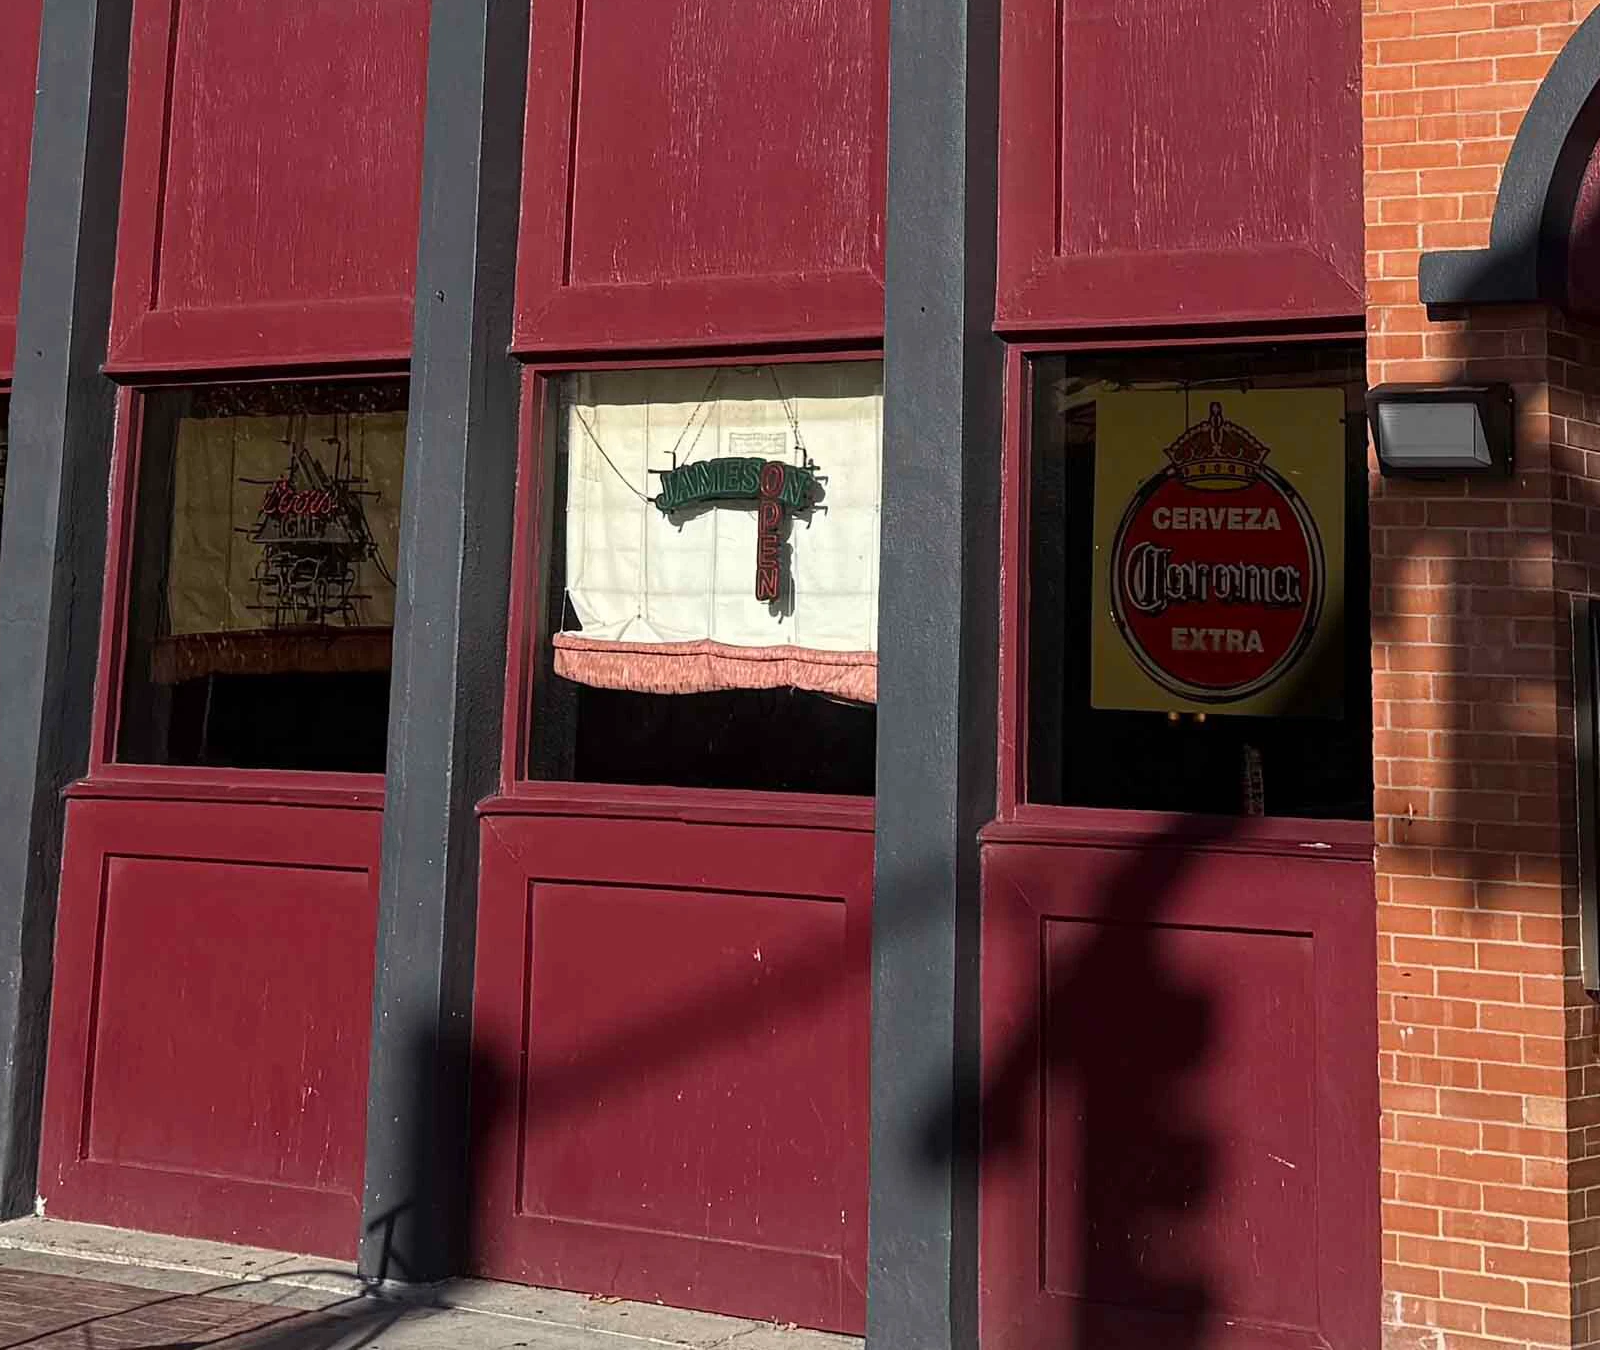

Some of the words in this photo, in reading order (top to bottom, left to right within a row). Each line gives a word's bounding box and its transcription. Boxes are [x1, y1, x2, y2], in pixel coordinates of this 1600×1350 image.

[658, 458, 809, 509] JAMESON
[757, 461, 784, 600] OPEN
[1152, 507, 1281, 531] CERVEZA
[1125, 542, 1302, 612] Corona
[1171, 627, 1264, 653] EXTRA
